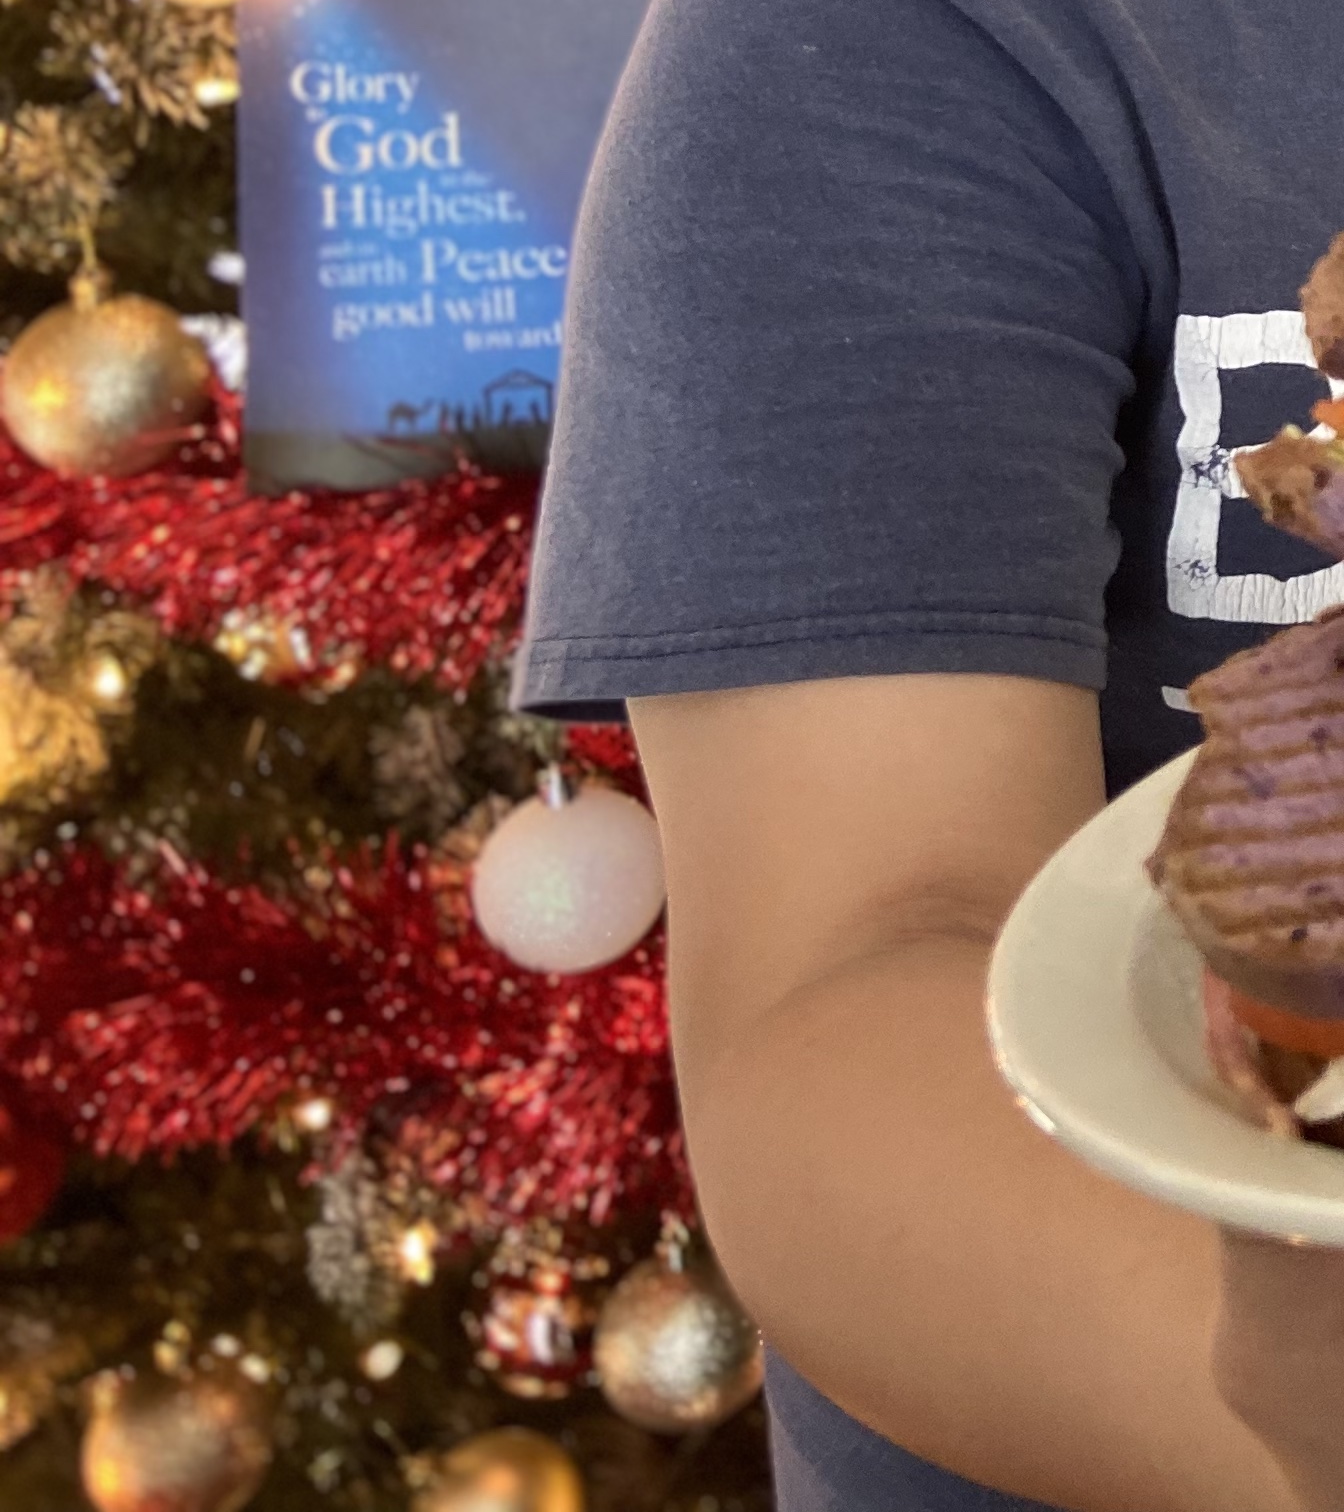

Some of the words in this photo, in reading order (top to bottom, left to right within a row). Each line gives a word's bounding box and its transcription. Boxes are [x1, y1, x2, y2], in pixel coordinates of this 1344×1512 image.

[289, 60, 419, 115] Glory
[314, 110, 463, 175] God
[322, 179, 528, 239] Highest.
[318, 252, 408, 288] earth
[420, 238, 567, 283] Peace
[333, 291, 434, 342] good
[442, 287, 517, 325] will
